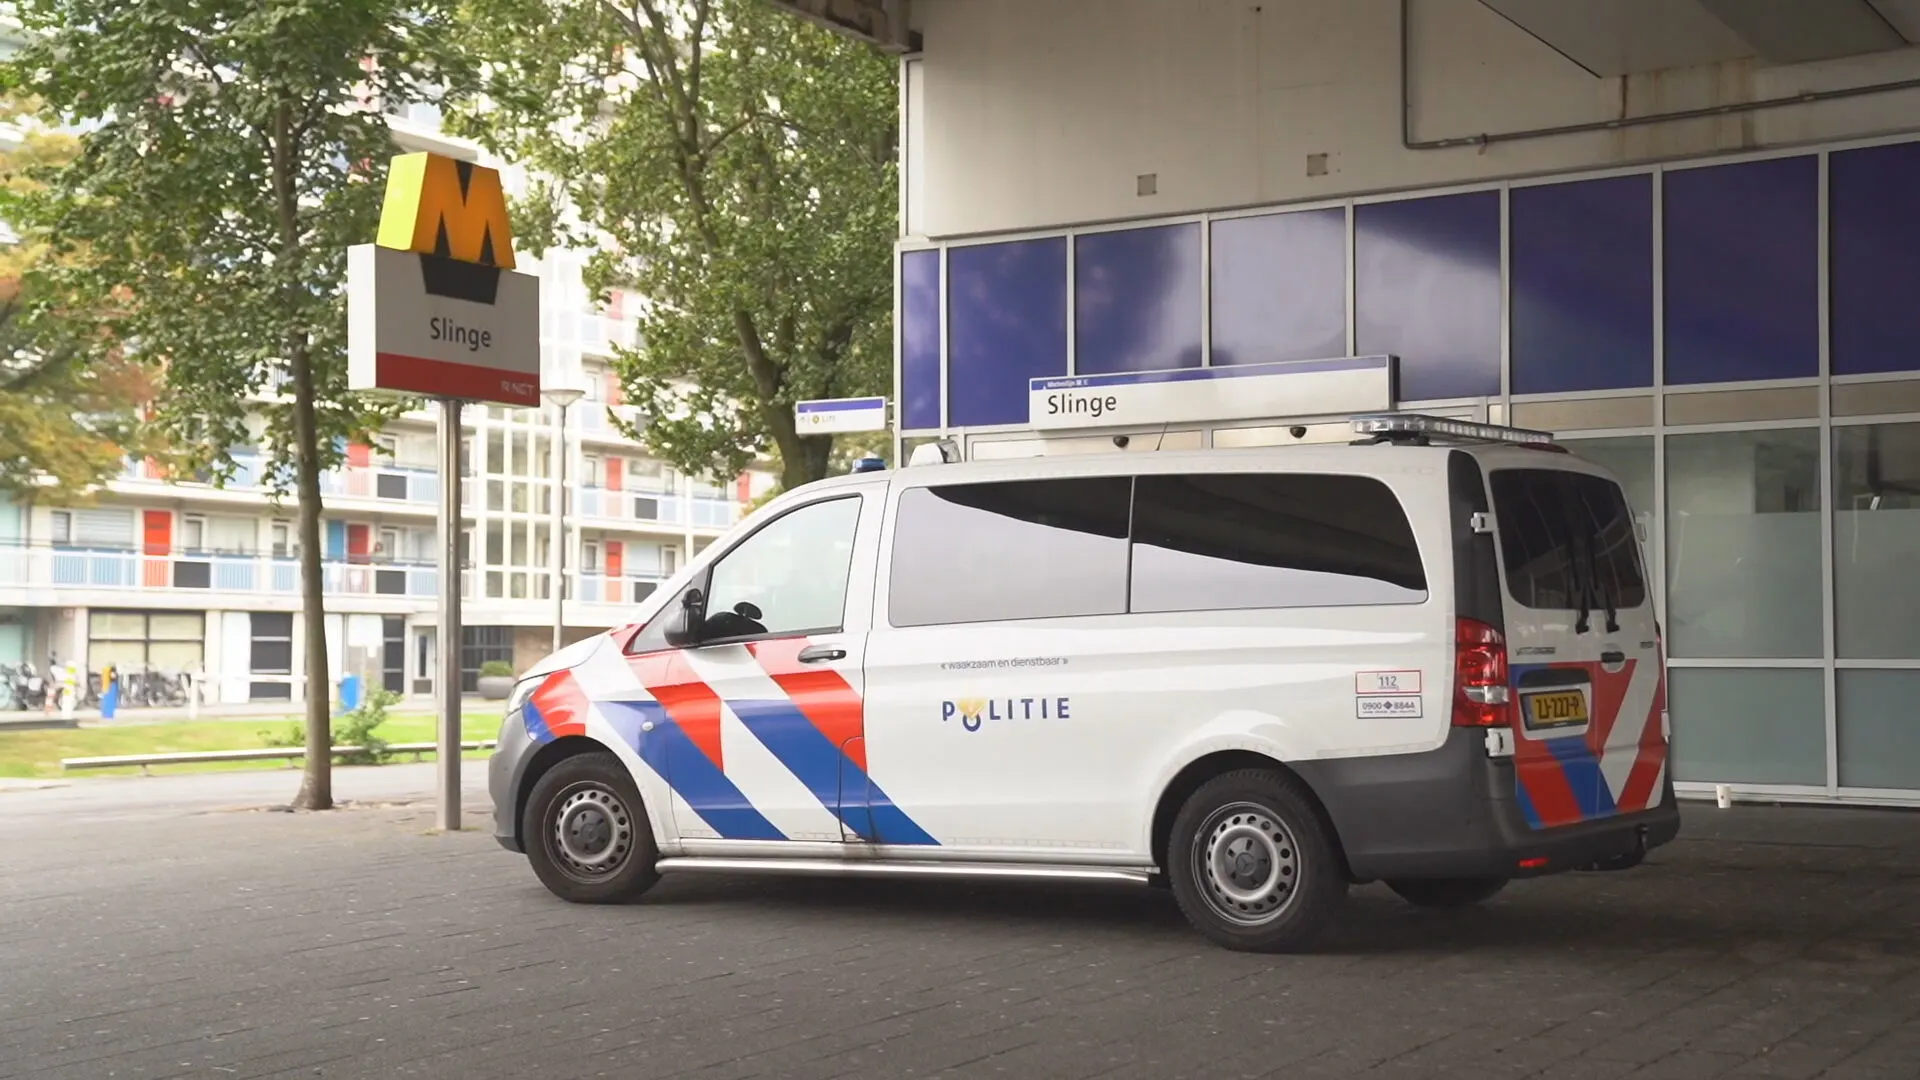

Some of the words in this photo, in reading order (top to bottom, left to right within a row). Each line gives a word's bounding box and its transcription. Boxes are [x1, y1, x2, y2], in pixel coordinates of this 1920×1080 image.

[410, 152, 516, 269] M
[430, 316, 492, 352] Slinge
[1047, 392, 1117, 417] Slinge
[948, 659, 996, 670] waakzaam
[998, 659, 1010, 667] en
[1011, 656, 1060, 667] dienstbaar
[1378, 675, 1397, 687] 112
[942, 697, 1070, 732] POLITIE
[1362, 702, 1382, 710] 0900
